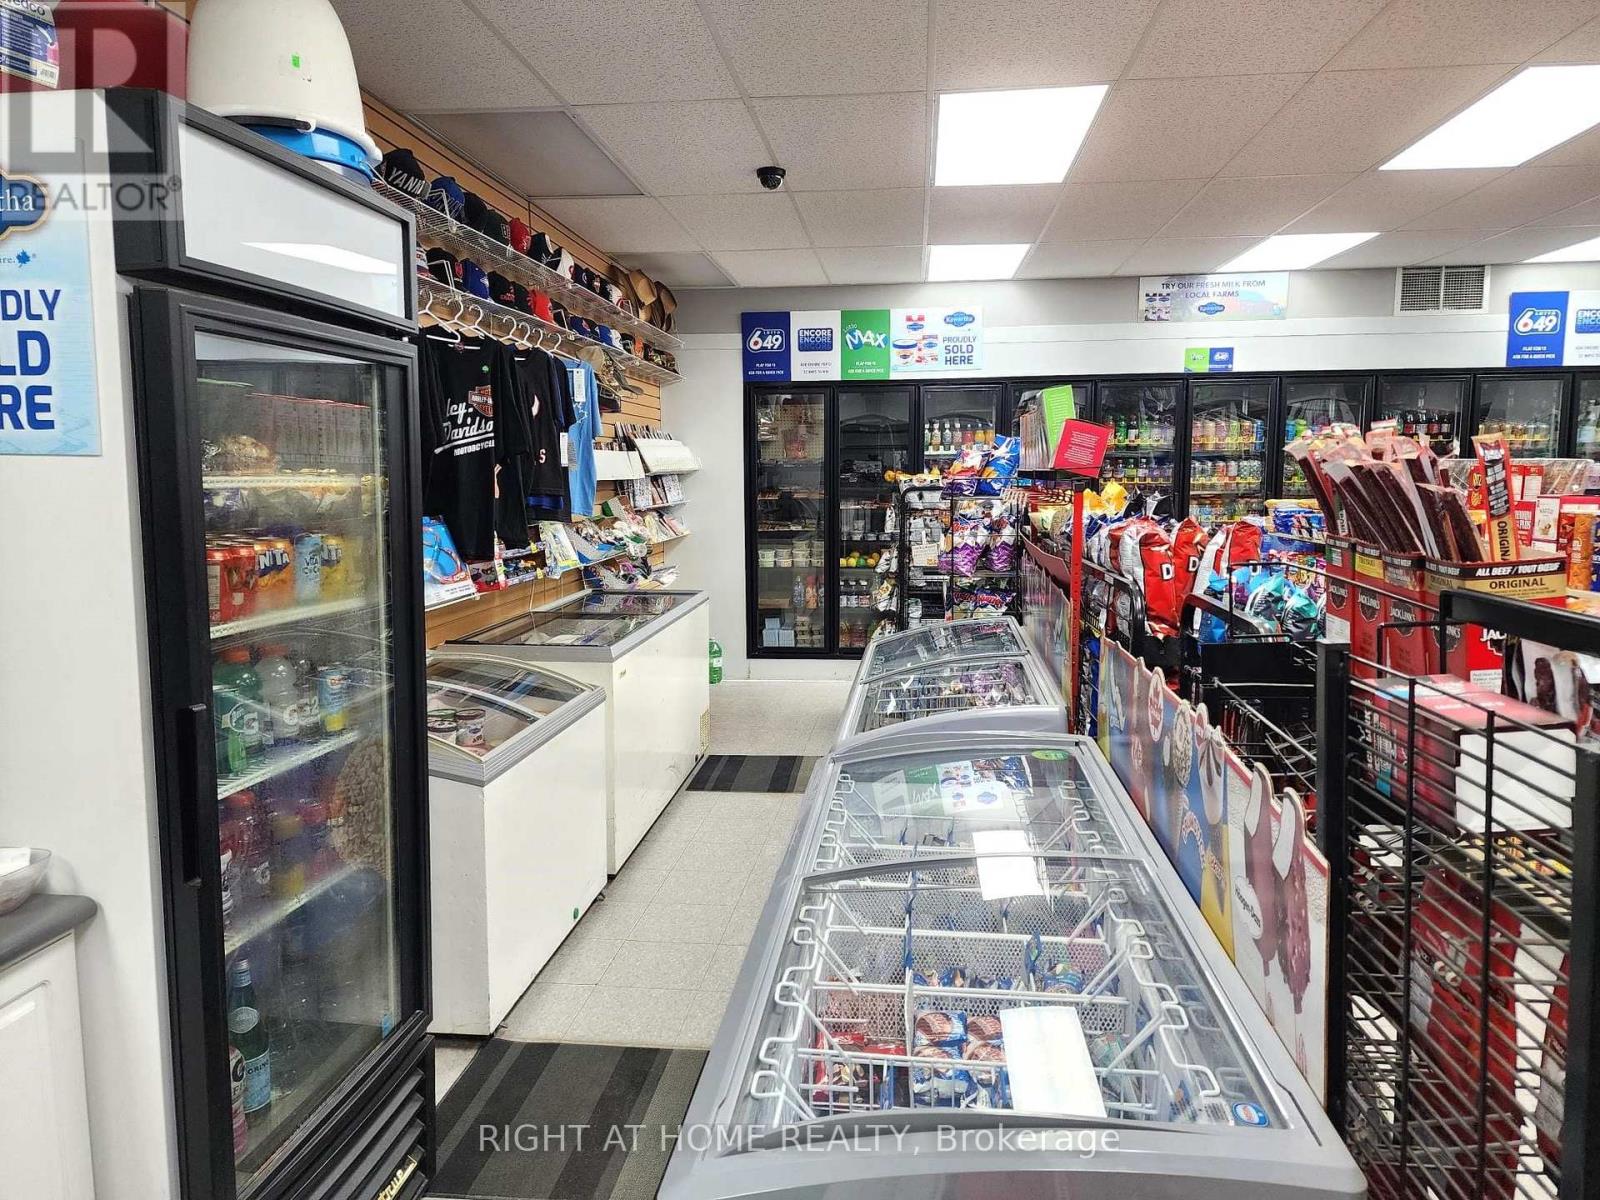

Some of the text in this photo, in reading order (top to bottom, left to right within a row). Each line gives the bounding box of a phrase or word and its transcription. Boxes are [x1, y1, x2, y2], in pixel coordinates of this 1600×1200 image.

[1178, 281, 1195, 289] OUR
[1196, 281, 1221, 289] FRESH
[1212, 290, 1240, 298] FARMS
[799, 329, 832, 337] ENCORE
[845, 329, 887, 350] MAX
[942, 336, 977, 344] PROUDLY
[944, 344, 974, 355] SOLD
[944, 355, 974, 366] HERE
[1475, 567, 1490, 577] ALL
[1489, 577, 1546, 589] ORIGINAL
